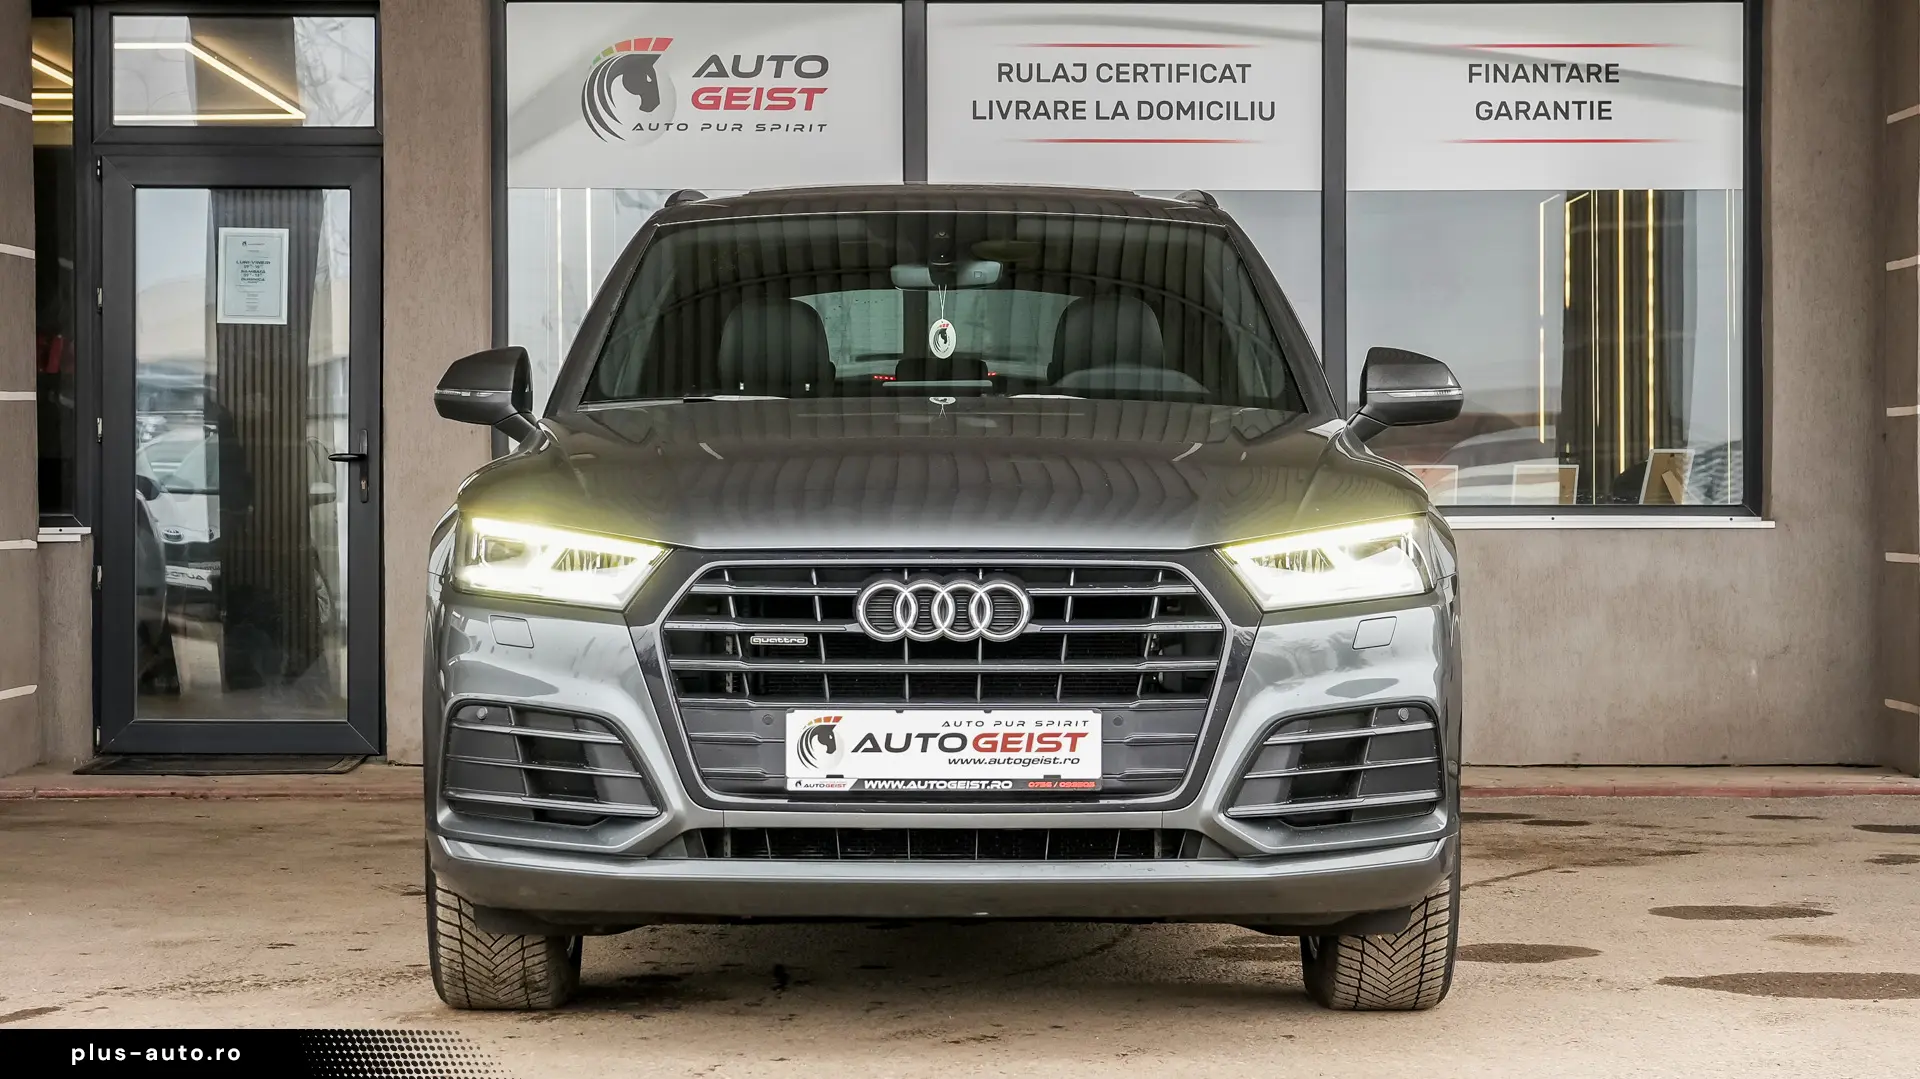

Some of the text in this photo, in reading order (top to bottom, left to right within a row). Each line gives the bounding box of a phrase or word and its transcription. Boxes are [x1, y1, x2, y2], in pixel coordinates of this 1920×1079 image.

[692, 55, 829, 79] AUTO
[997, 62, 1252, 84] RULAJ CERTIFICAT
[1468, 63, 1620, 83] FINANTARE
[691, 87, 829, 111] GEIST
[972, 100, 1276, 121] LIVRARE LA DOMICILIU
[1475, 100, 1613, 121] GARANTIE
[632, 122, 828, 133] AUTO PUR SPIRIT
[941, 720, 1090, 728] AUTO PUR SPIRIT
[948, 756, 1081, 768] www.autogeist.ro
[864, 780, 1013, 789] WWW.AUTOGEIST.RO
